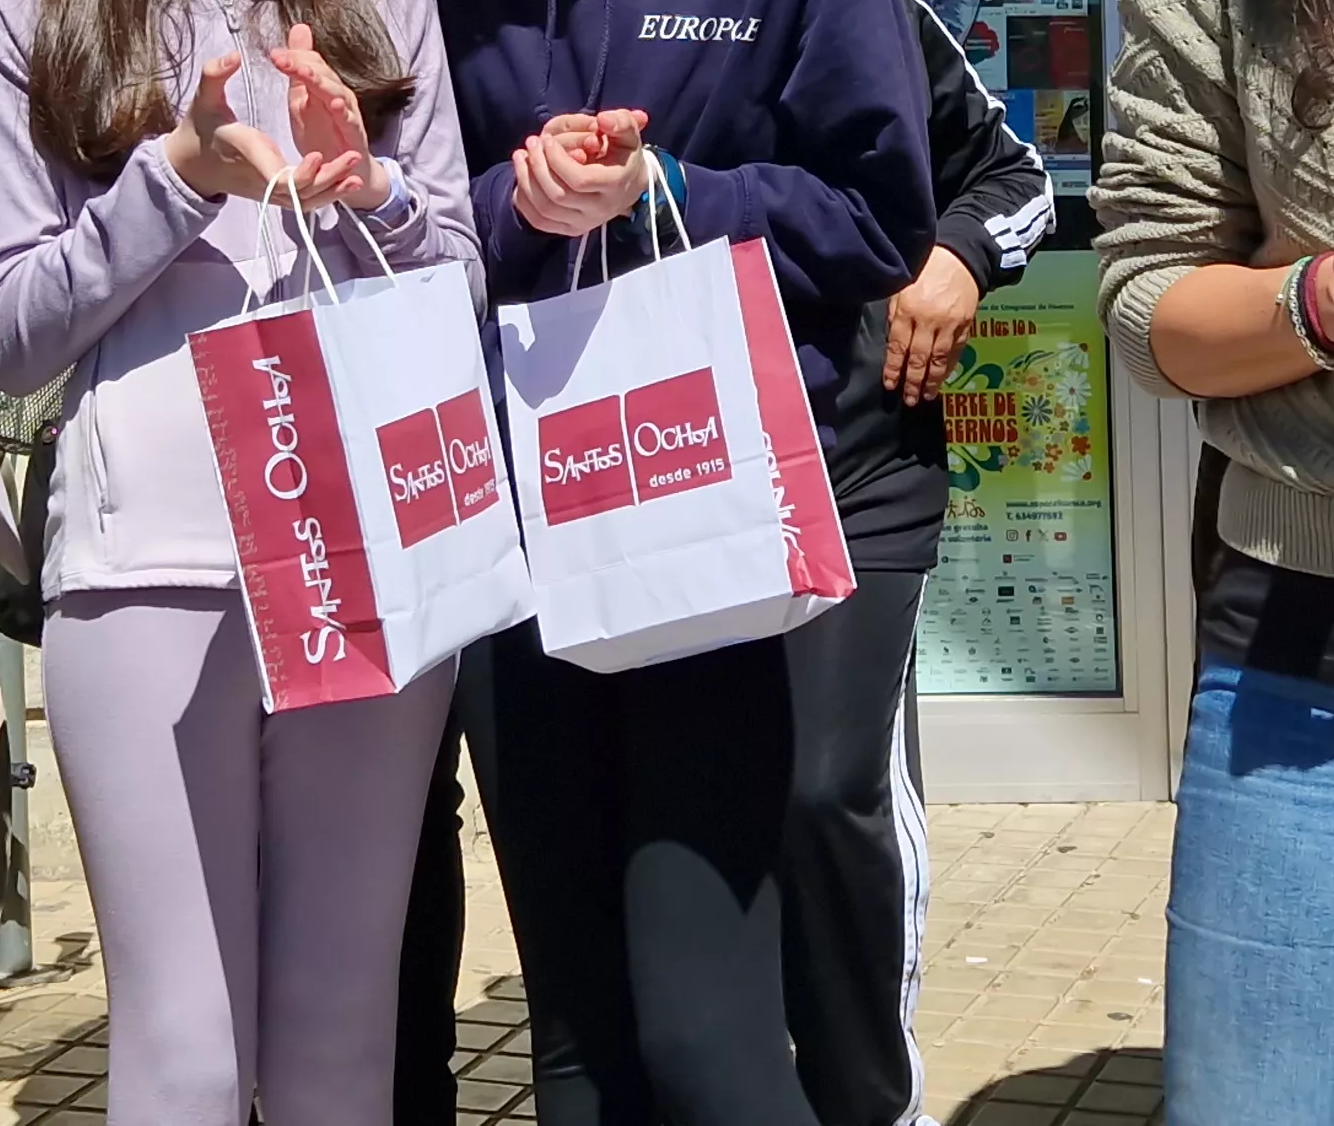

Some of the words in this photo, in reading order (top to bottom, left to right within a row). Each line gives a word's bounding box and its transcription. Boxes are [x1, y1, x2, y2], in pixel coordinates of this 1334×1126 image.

[990, 317, 1009, 337] las
[1012, 318, 1026, 336] 10
[945, 392, 987, 417] ERTE
[994, 392, 1016, 416] DE
[945, 417, 1019, 443] CERNOS
[649, 468, 692, 488] desde
[696, 458, 725, 477] 1915
